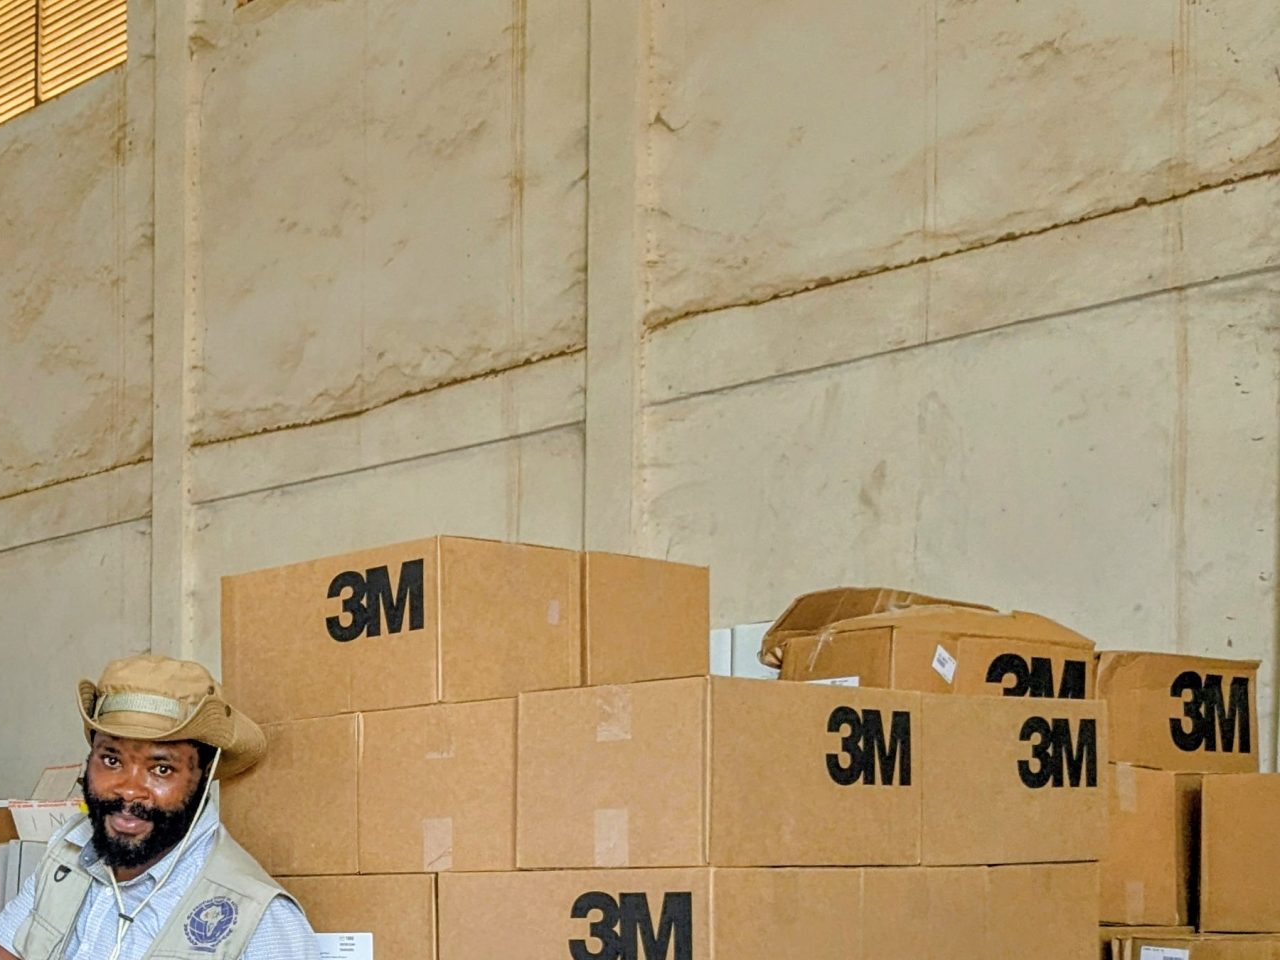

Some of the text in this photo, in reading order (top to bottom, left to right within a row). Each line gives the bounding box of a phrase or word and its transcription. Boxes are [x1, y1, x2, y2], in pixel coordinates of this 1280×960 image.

[325, 558, 424, 643] 3M
[985, 653, 1086, 698] 3M
[1168, 670, 1251, 754] 3M
[825, 705, 912, 786] 3M
[1017, 716, 1098, 789] 3M
